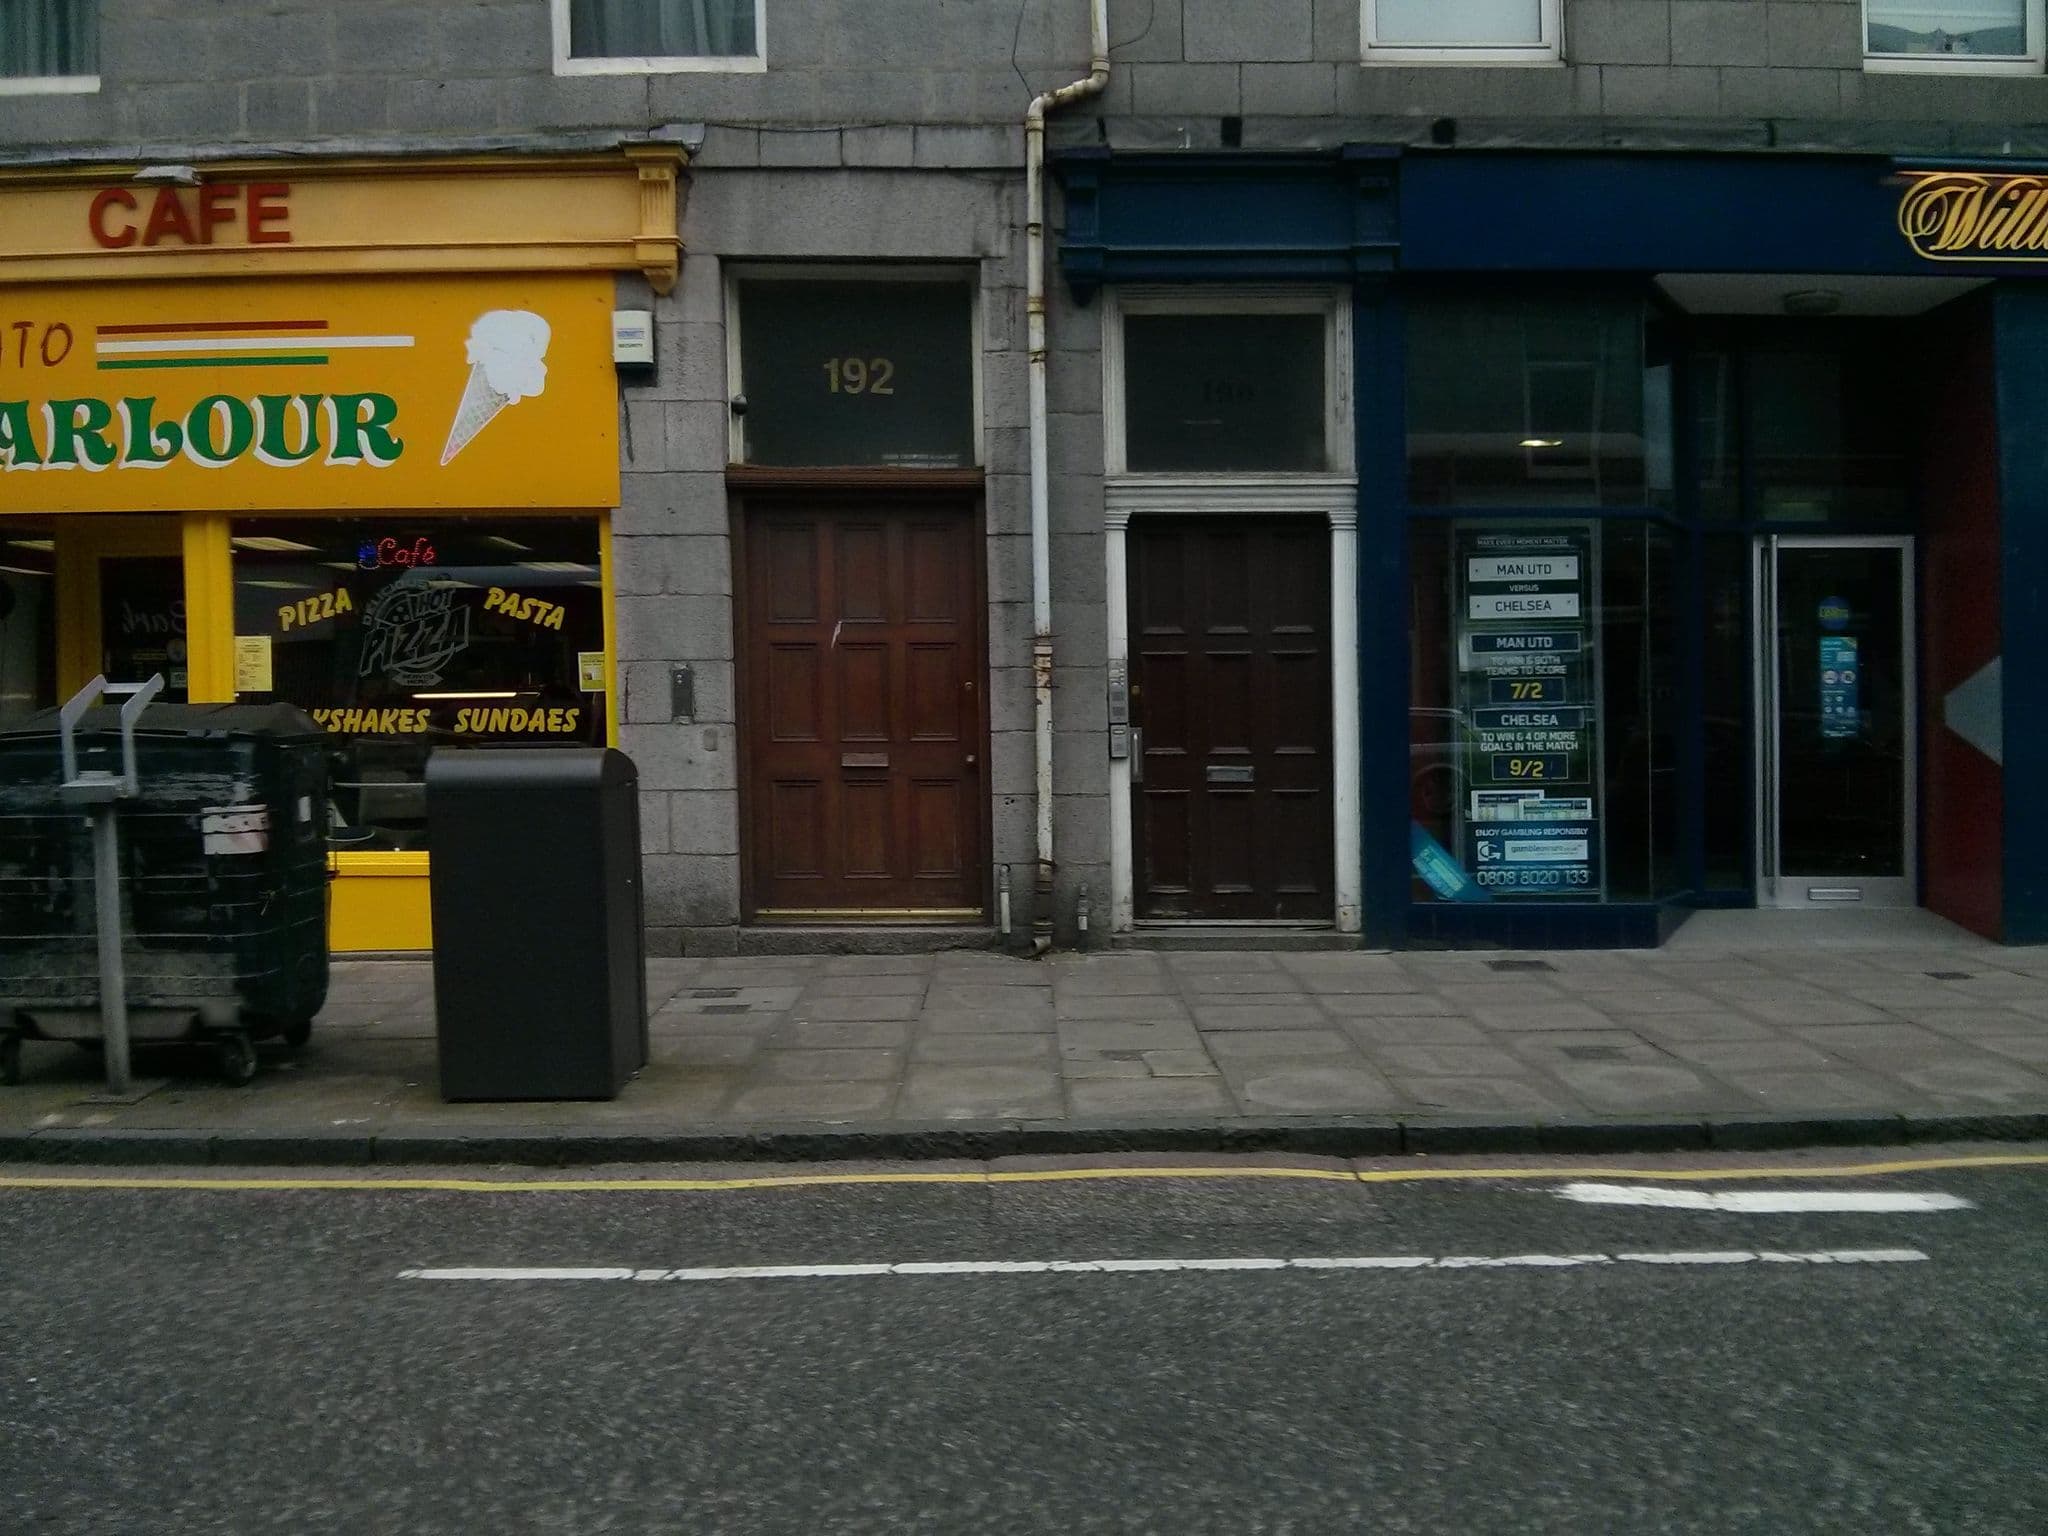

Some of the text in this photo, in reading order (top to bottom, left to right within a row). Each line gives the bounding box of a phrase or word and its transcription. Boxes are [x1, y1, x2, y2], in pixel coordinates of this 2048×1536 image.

[89, 183, 291, 248] CAFE
[0, 321, 73, 369] TO
[823, 357, 895, 396] 192
[1496, 563, 1552, 575] MAN UTD
[1508, 584, 1540, 592] VERSUS
[279, 588, 352, 631] PIZZA
[483, 587, 565, 630] PASTA
[1495, 600, 1552, 612] CHELSEA
[1496, 636, 1553, 648] MAN UTD
[1486, 665, 1568, 675] TEAMS TO SCORE
[1509, 682, 1544, 700] 7/2
[454, 708, 580, 734] SUNDAES
[1500, 714, 1559, 726] CHELSEA
[1481, 732, 1495, 742] TO
[1496, 732, 1515, 741] WIN
[1525, 732, 1532, 740] 4
[1533, 732, 1547, 741] OR
[1549, 731, 1577, 740] MORE
[1480, 741, 1578, 752] GOALS IN THE MATCH
[1509, 759, 1544, 777] 9/2
[1476, 869, 1590, 886] 0808 8020 133
